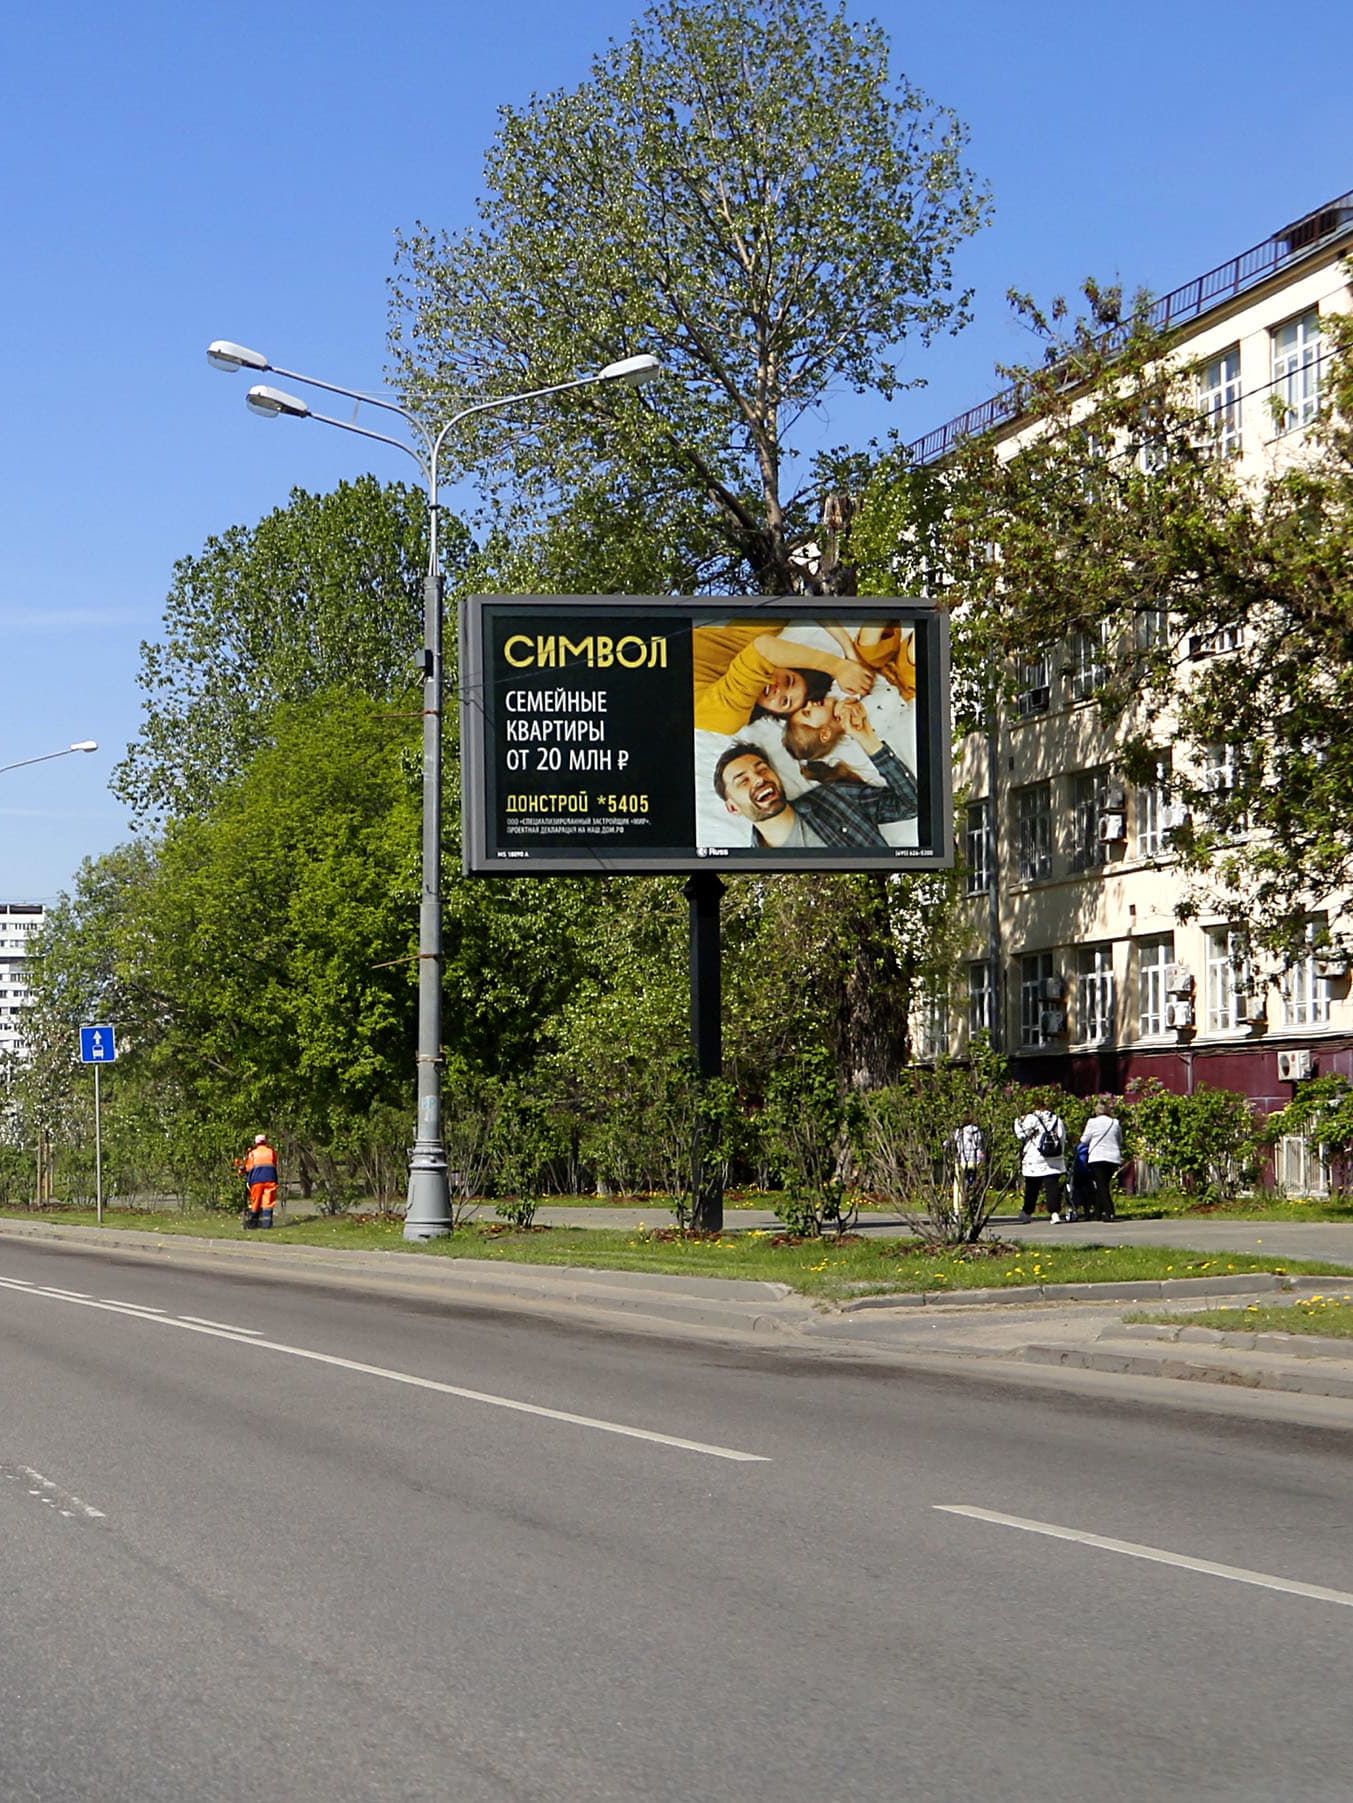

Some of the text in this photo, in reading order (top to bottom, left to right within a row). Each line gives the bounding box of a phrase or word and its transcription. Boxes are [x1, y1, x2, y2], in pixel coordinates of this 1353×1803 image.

[503, 634, 668, 669] СИМВОЛ
[505, 687, 608, 712] СЕМЕЙНЫЕ
[506, 719, 605, 742] КВАРТИРЫ
[506, 748, 530, 771] ОТ
[536, 747, 562, 771] 20
[569, 749, 612, 771] МЛН
[505, 790, 588, 813] ДОНСТРОЙ
